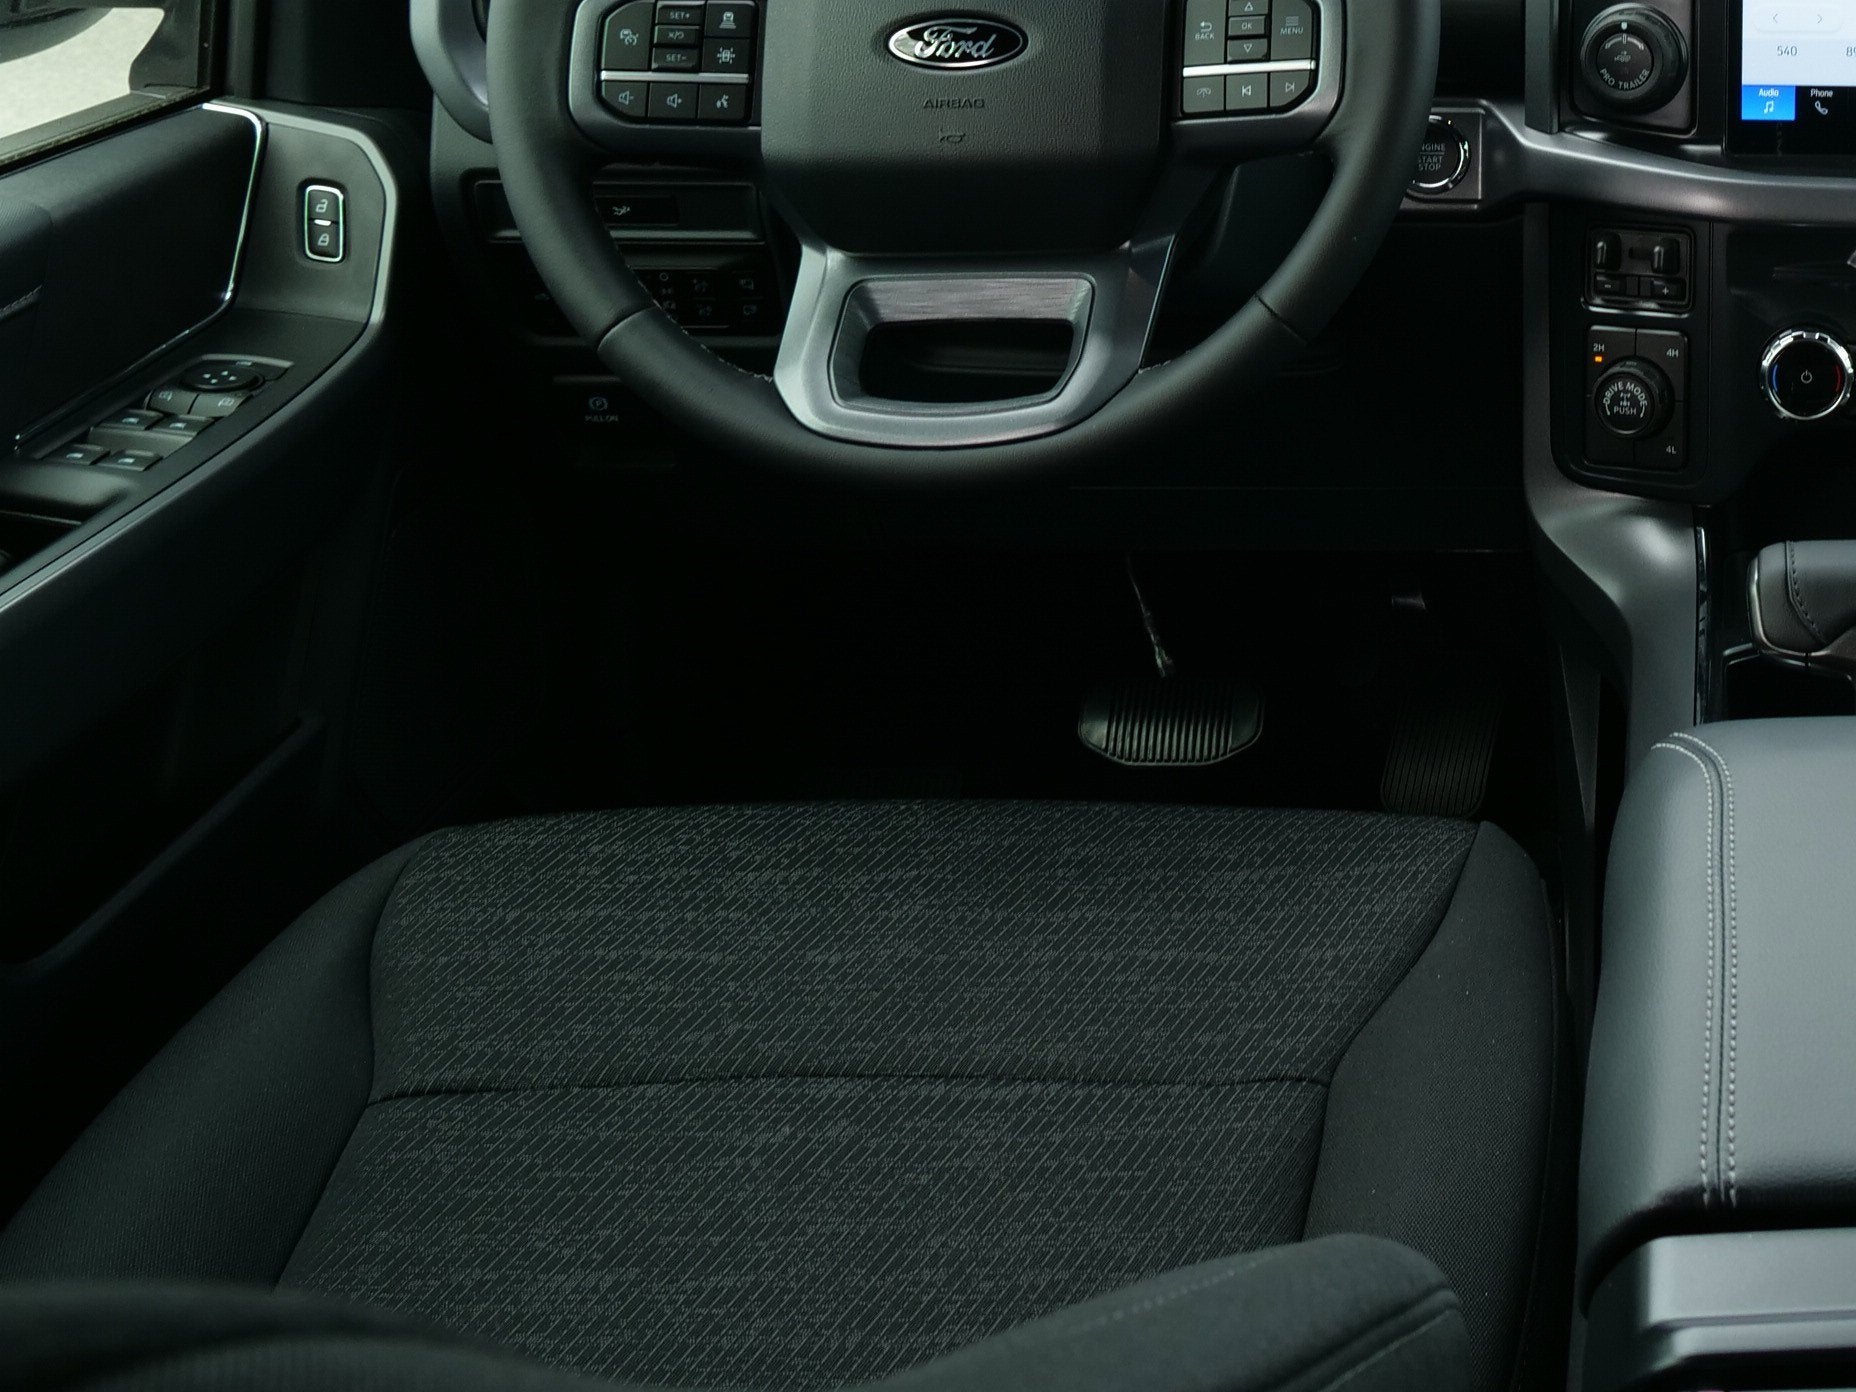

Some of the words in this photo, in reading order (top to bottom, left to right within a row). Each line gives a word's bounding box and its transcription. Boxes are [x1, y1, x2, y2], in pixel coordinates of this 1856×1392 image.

[669, 11, 690, 20] SET+
[1241, 22, 1253, 30] OK
[1280, 27, 1304, 35] MENU
[1194, 33, 1215, 41] BACK
[1777, 45, 1798, 57] 540
[1758, 88, 1779, 98] Audio
[1810, 88, 1834, 98] Phone
[923, 97, 986, 109] AIRBAG
[1592, 342, 1606, 353] 2H
[1666, 348, 1679, 358] 4H
[1602, 381, 1623, 405] DRIVE
[1625, 381, 1648, 407] MODE
[1613, 406, 1637, 416] PUSH
[1665, 445, 1677, 455] 4L
